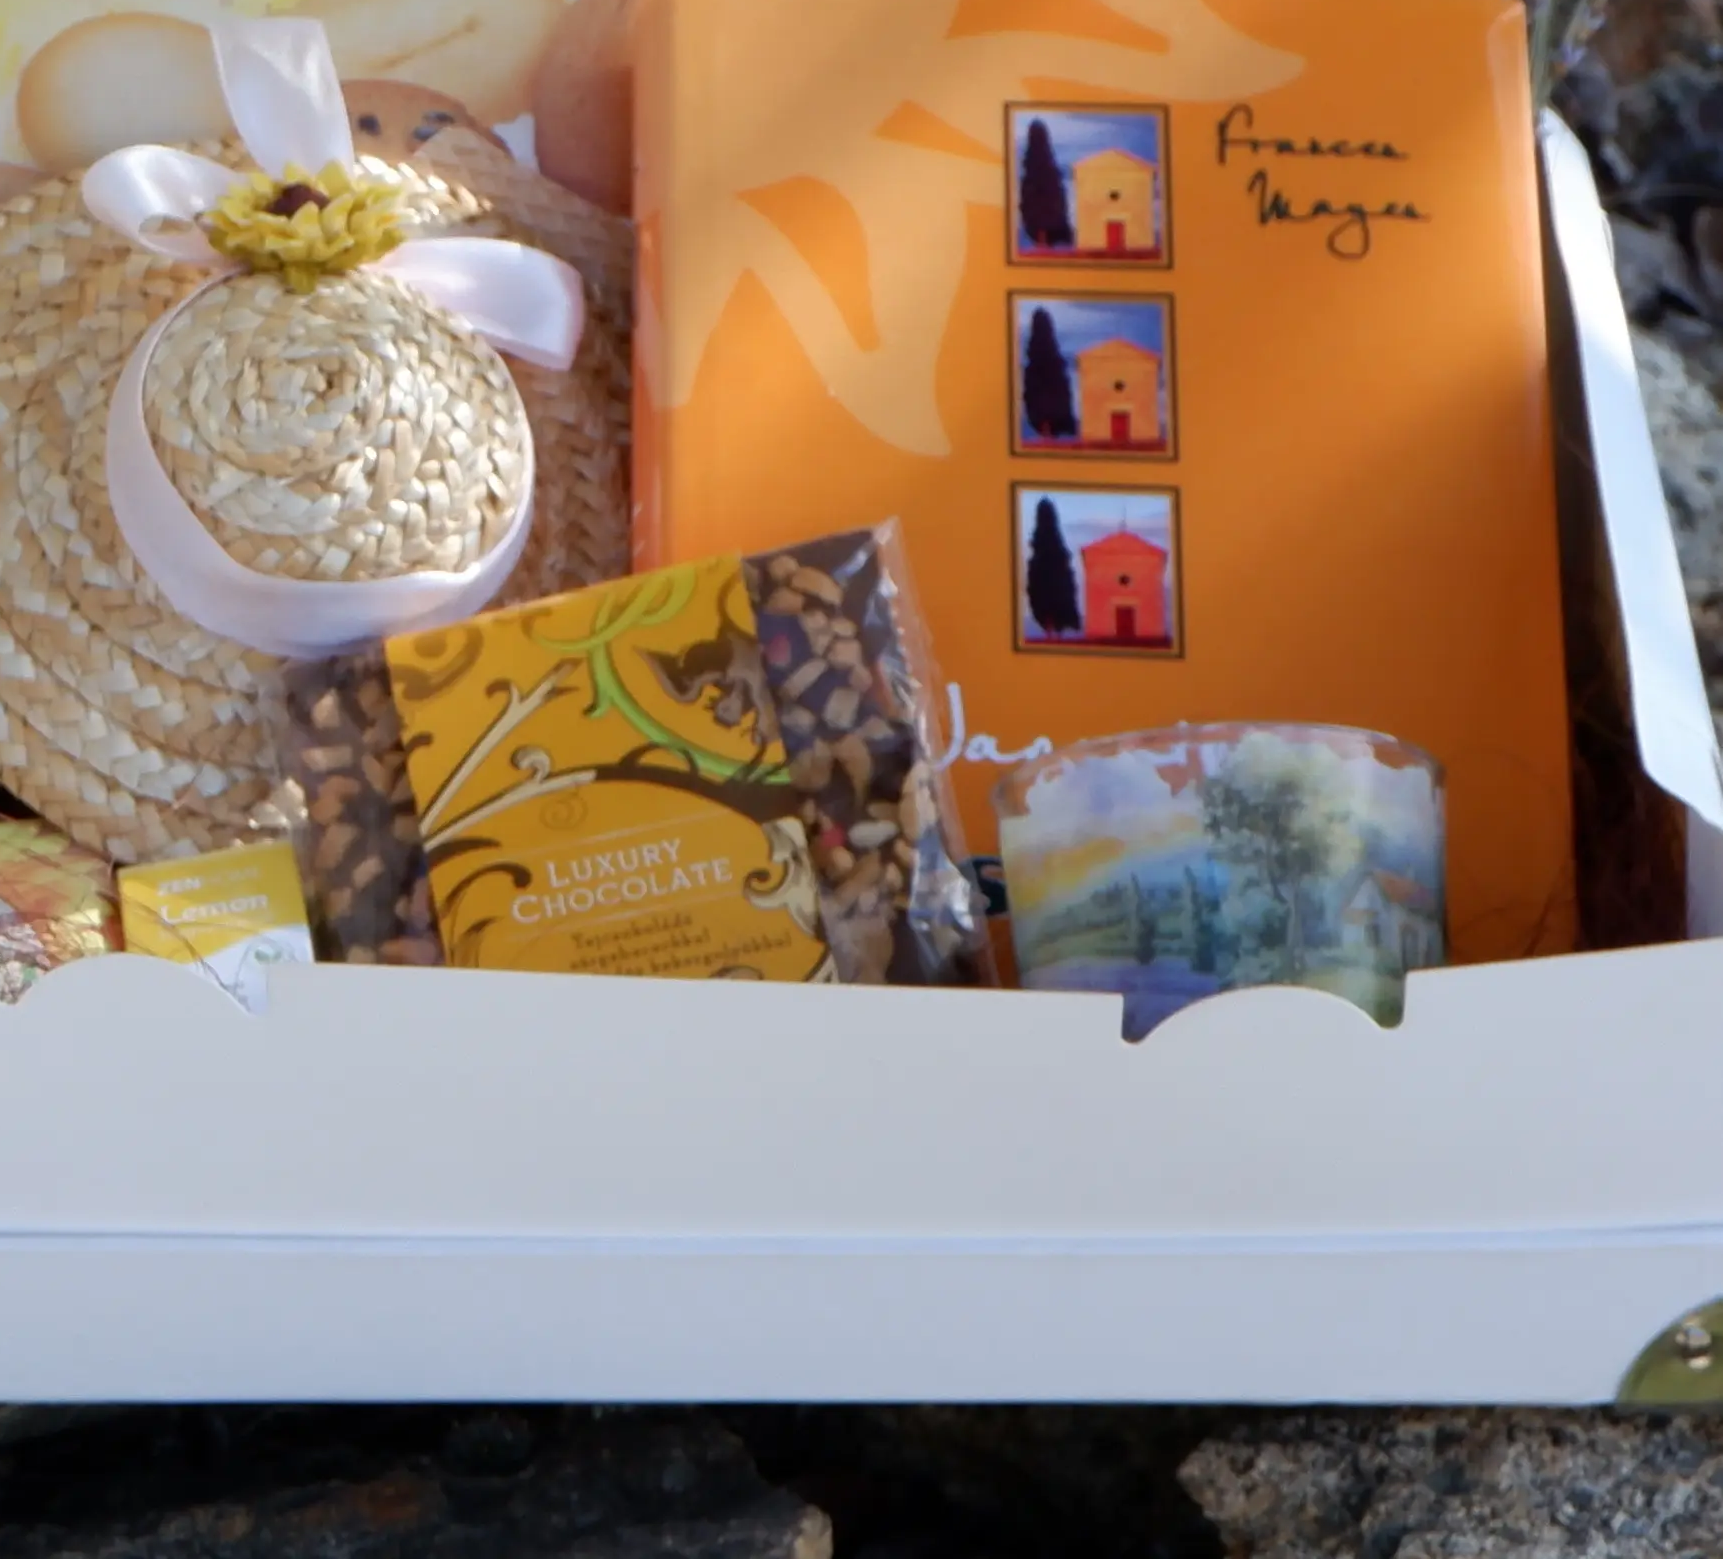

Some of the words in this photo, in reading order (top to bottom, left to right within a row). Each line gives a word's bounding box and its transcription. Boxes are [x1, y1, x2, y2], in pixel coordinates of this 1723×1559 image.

[510, 856, 734, 924] CHOCOLATE
[545, 837, 683, 890] LUXURY
[159, 893, 270, 926] Lemon
